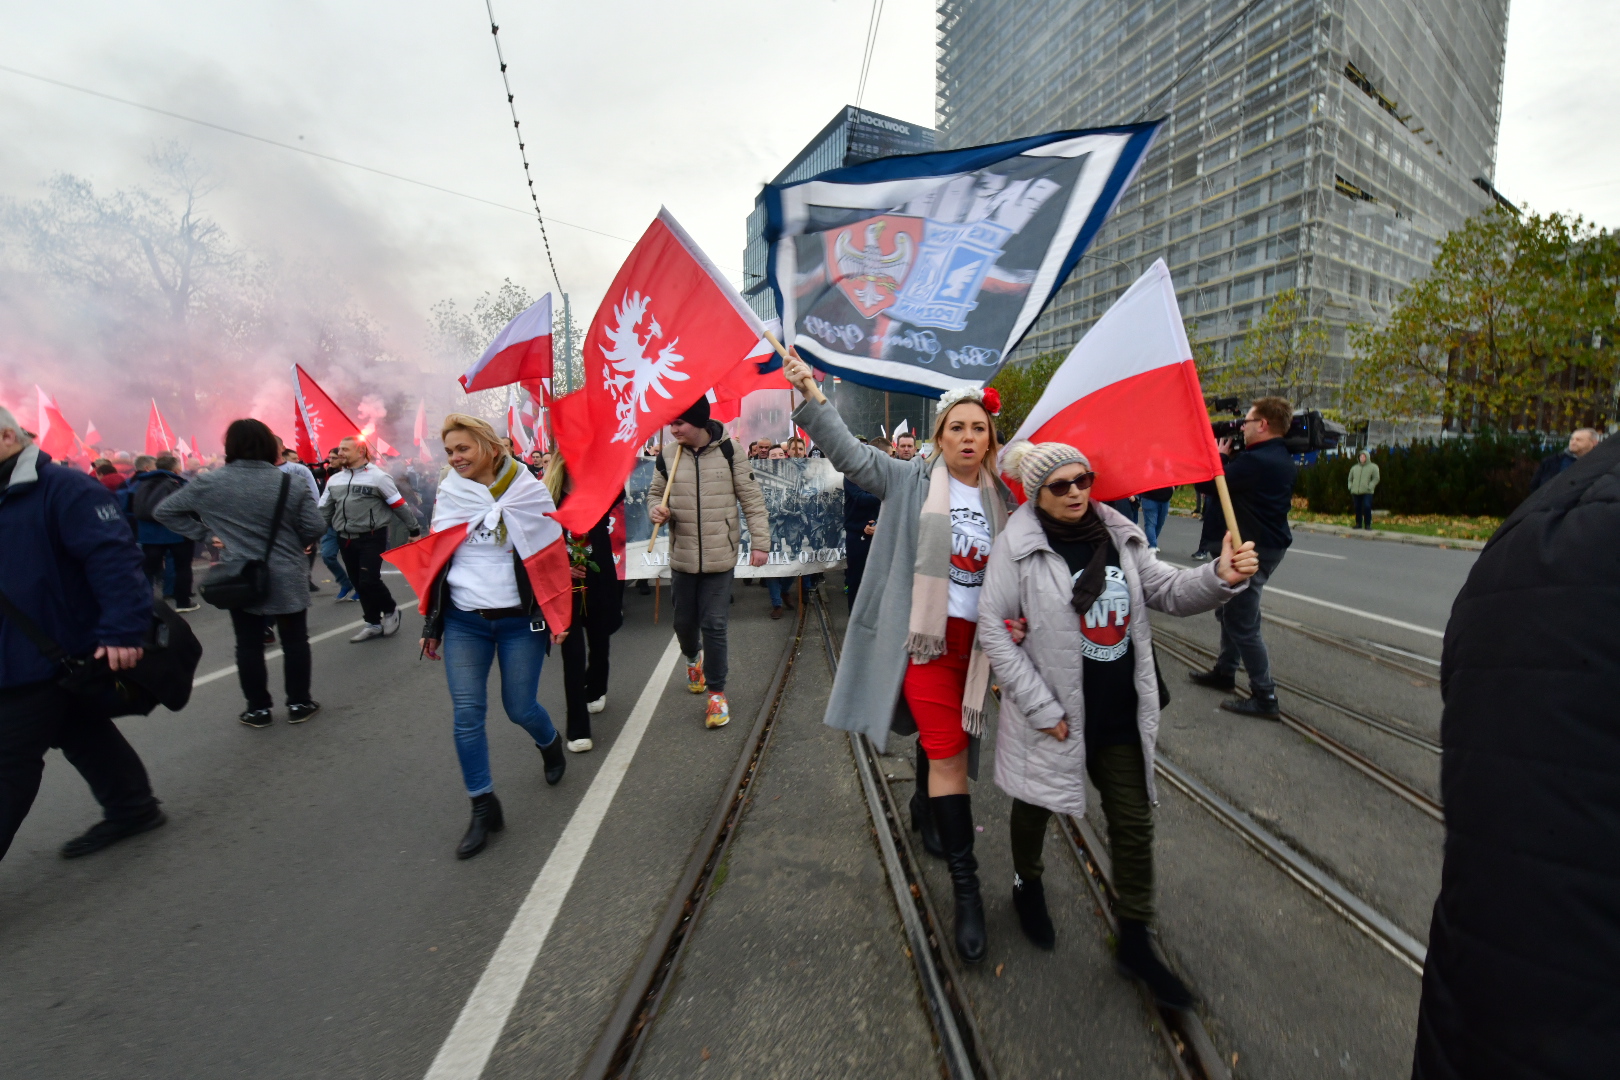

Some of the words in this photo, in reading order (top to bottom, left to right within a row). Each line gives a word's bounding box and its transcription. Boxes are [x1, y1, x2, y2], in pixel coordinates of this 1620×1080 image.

[860, 113, 910, 135] ROCKWOOL
[737, 552, 791, 566] ZIMIA
[952, 533, 991, 561] WP
[1084, 598, 1130, 629] WP
